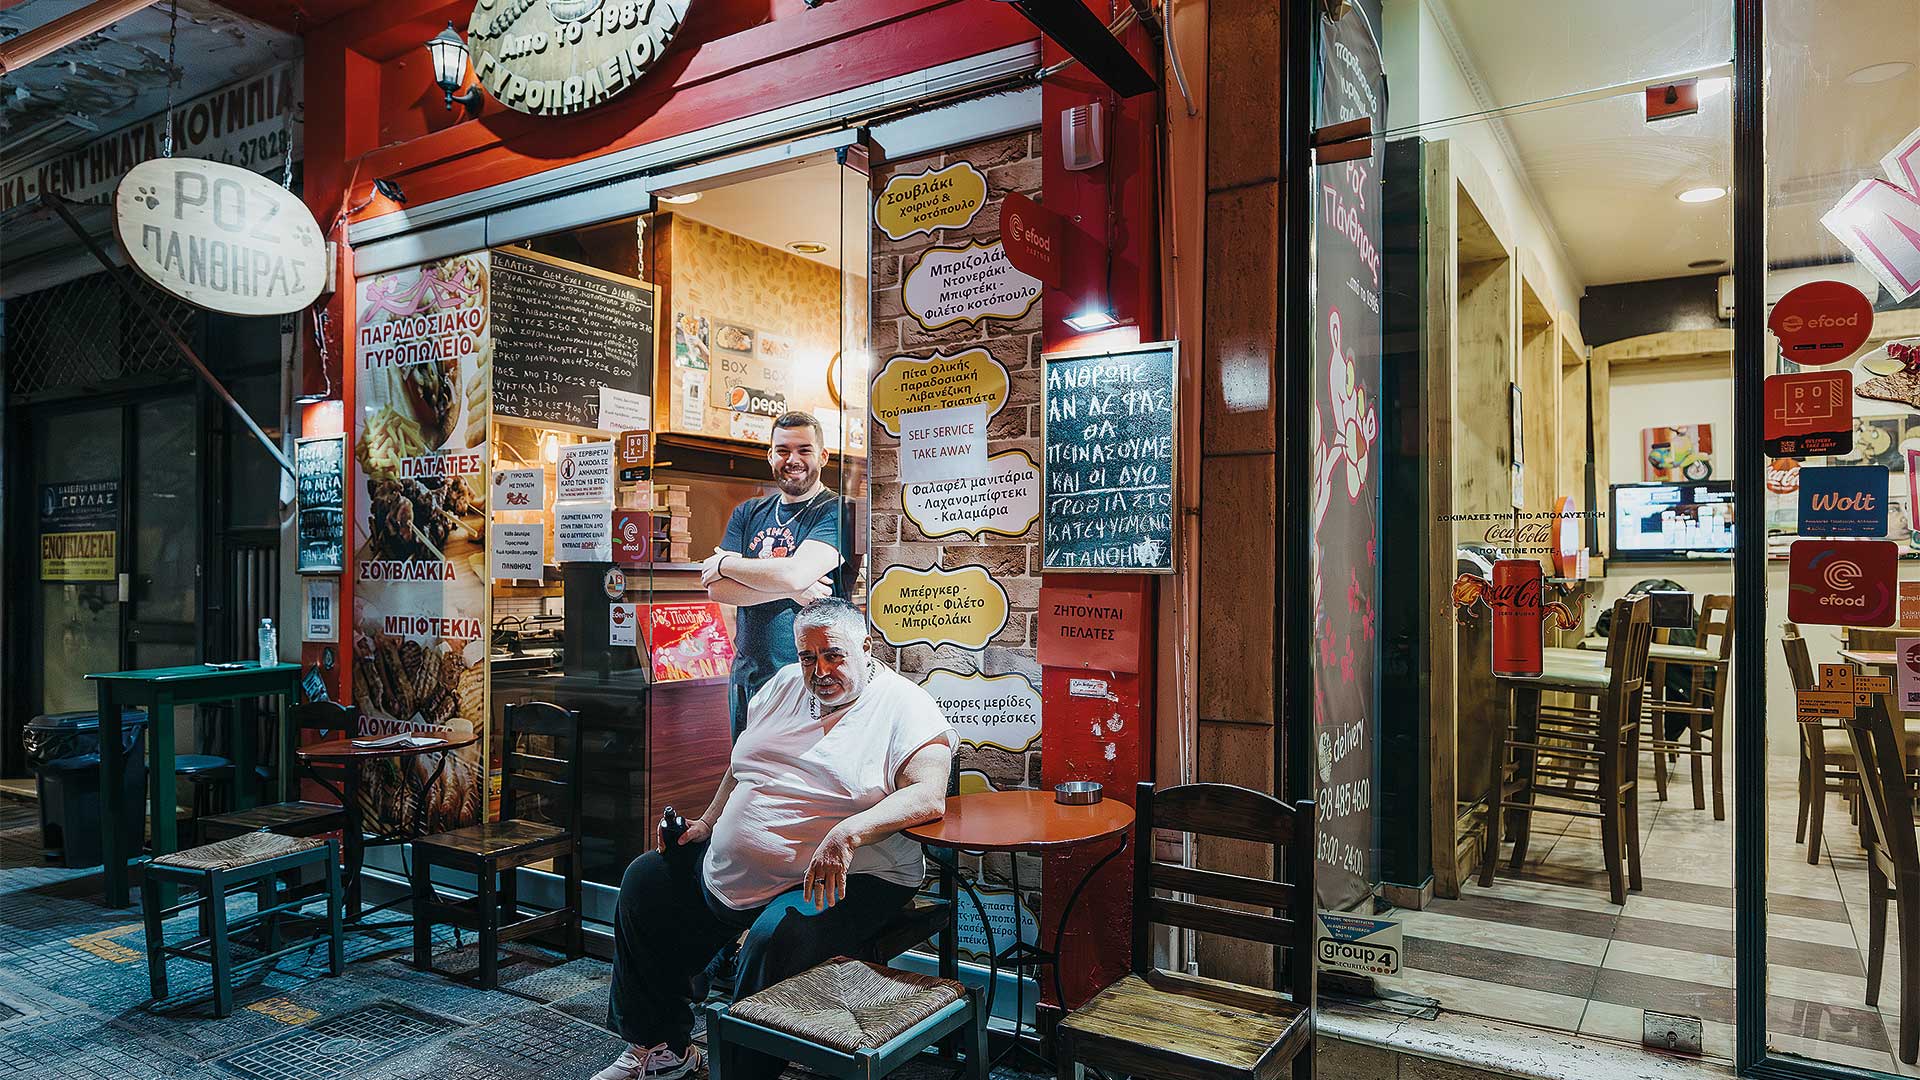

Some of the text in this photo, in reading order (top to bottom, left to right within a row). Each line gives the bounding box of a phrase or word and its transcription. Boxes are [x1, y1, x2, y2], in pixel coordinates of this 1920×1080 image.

[592, 2, 651, 35] 1987
[475, 2, 678, 109] ΓΥΡΟΠΩΛΕΙΟΝ
[887, 178, 953, 205] Σουβλάκι
[174, 171, 281, 243] ΡΟΖ
[900, 193, 951, 218] χοιρινό &
[913, 199, 974, 224] κοτόπουλο
[1025, 228, 1050, 251] efood
[1324, 185, 1380, 287] Πάνθηρας
[142, 224, 306, 298] ΠΑΝΘΗΡΑΣ
[943, 264, 1006, 289] Ντονεράκι
[924, 286, 1037, 320] Φιλέτο κοτόπουλο
[939, 280, 997, 303] Μπιφτέκι
[361, 308, 481, 346] ΠΑΡΑΔΟΣΙΑΚΟ
[1807, 312, 1858, 329] efood
[365, 337, 472, 370] ΓΥΡΟΠΩΛΕΙΟ
[721, 358, 748, 376] BOX
[902, 359, 970, 380] Πίτα Ολικής
[1049, 362, 1148, 391] ΑΝΘΡΩΠΕ
[900, 369, 978, 393] Παραδοσιακή
[751, 396, 788, 417] pepsi
[940, 392, 997, 410] Τσιαπάτα
[1049, 397, 1076, 422] ΑΝ
[1122, 389, 1171, 417] ΦΑΣ
[909, 423, 974, 441] SELF SERVICE
[1083, 420, 1116, 440] ΘΑ
[912, 444, 972, 460] TAKE AWAY
[1048, 436, 1171, 464] ΠΕΙΝΑΣΟΥΜΕ
[401, 455, 480, 477] ΠΑΤΑΤΕΣ
[912, 470, 1034, 496] Φαλαφέλ μανιτάρια
[1052, 464, 1156, 492] ΚΑΙ ΟΙ ΔΥΟ
[62, 493, 114, 508] ΓΟΥΛΑΣ
[925, 487, 1027, 511] Λαχανομπίφτεκι
[1811, 491, 1875, 511] Wolt
[942, 504, 1009, 523] Καλαμάρια
[1437, 513, 1491, 521] ΔΟΚΙΜΑΣΕΣ
[1515, 512, 1533, 520] ΠΙΟ
[1535, 511, 1606, 520] ΑΠΟΛΑΥΣΤΙΚΗ
[1484, 523, 1552, 544] Coca-Cola
[43, 533, 114, 559] ΕΝΟΙΚΙΑΖΕΤΑΙ
[1479, 547, 1498, 555] ΠΟΥ
[1501, 547, 1528, 555] ΕΓΙΝΕ
[360, 561, 456, 581] ΣΟΥΒΛΑΚΙΑ
[501, 562, 532, 571] ΠΑΝΘΗΡΑΣ
[900, 584, 960, 601] Μπέργκερ
[1819, 594, 1865, 607] efood
[311, 596, 330, 619] BEER
[883, 595, 985, 617] Μοσχάρι Φιλέτο
[1053, 604, 1123, 620] ΖΗΤΟΥΝΤΑΙ
[385, 616, 482, 638] ΜΠΙΦΤΕΚΙΑ
[901, 612, 972, 631] Μπριζολάκι
[1060, 625, 1115, 641] ΠΕΛΑΤΕΣ
[983, 694, 1032, 711] μερίδες
[982, 710, 1036, 727] φρέσκες
[1333, 719, 1364, 763] delivery
[1335, 782, 1351, 818] 485
[1352, 778, 1370, 814] 4600
[1343, 844, 1364, 876] 24:00
[1324, 943, 1391, 967] group 4
